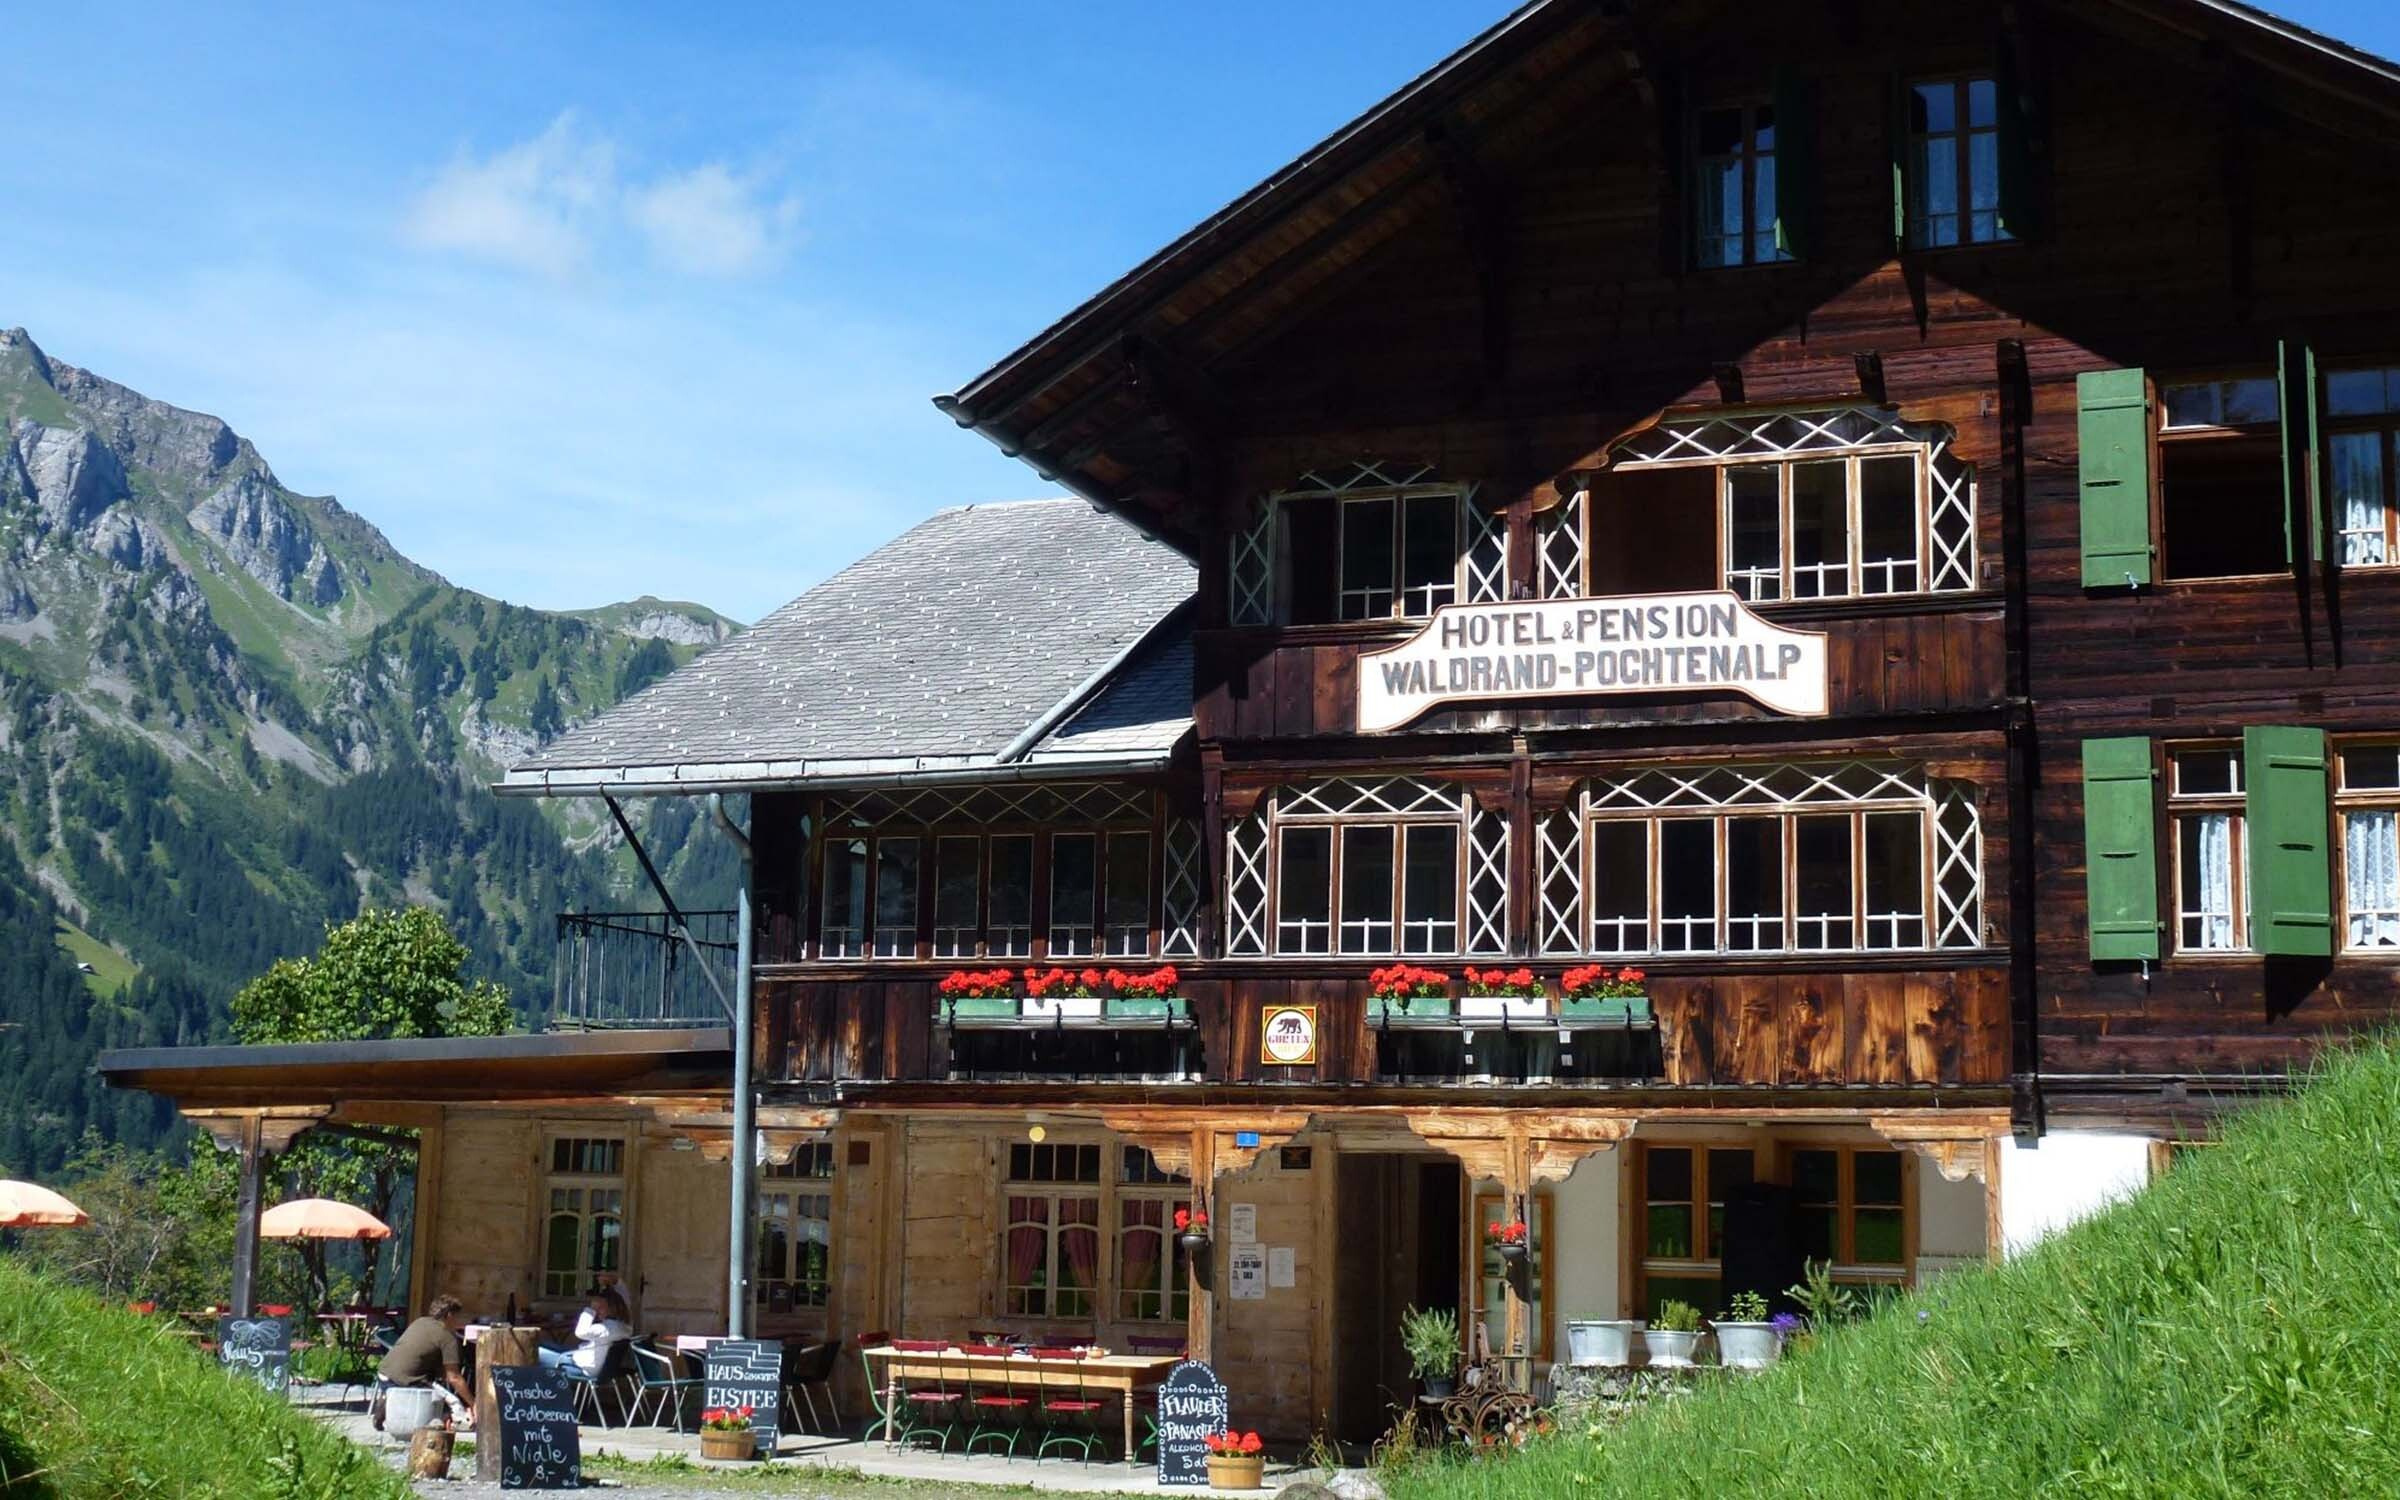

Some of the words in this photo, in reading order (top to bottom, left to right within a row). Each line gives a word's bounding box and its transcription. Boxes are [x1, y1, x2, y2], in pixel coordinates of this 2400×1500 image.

[1441, 611, 1556, 649] HOTEL
[1561, 619, 1575, 639] &
[1576, 602, 1738, 643] PENSION
[1380, 643, 1802, 696] WALDRAND-POCHTENALP
[706, 1386, 778, 1409] EISTEE
[503, 1404, 583, 1425] Erdbeeren
[523, 1424, 553, 1443] mit
[512, 1442, 568, 1465] Nidle
